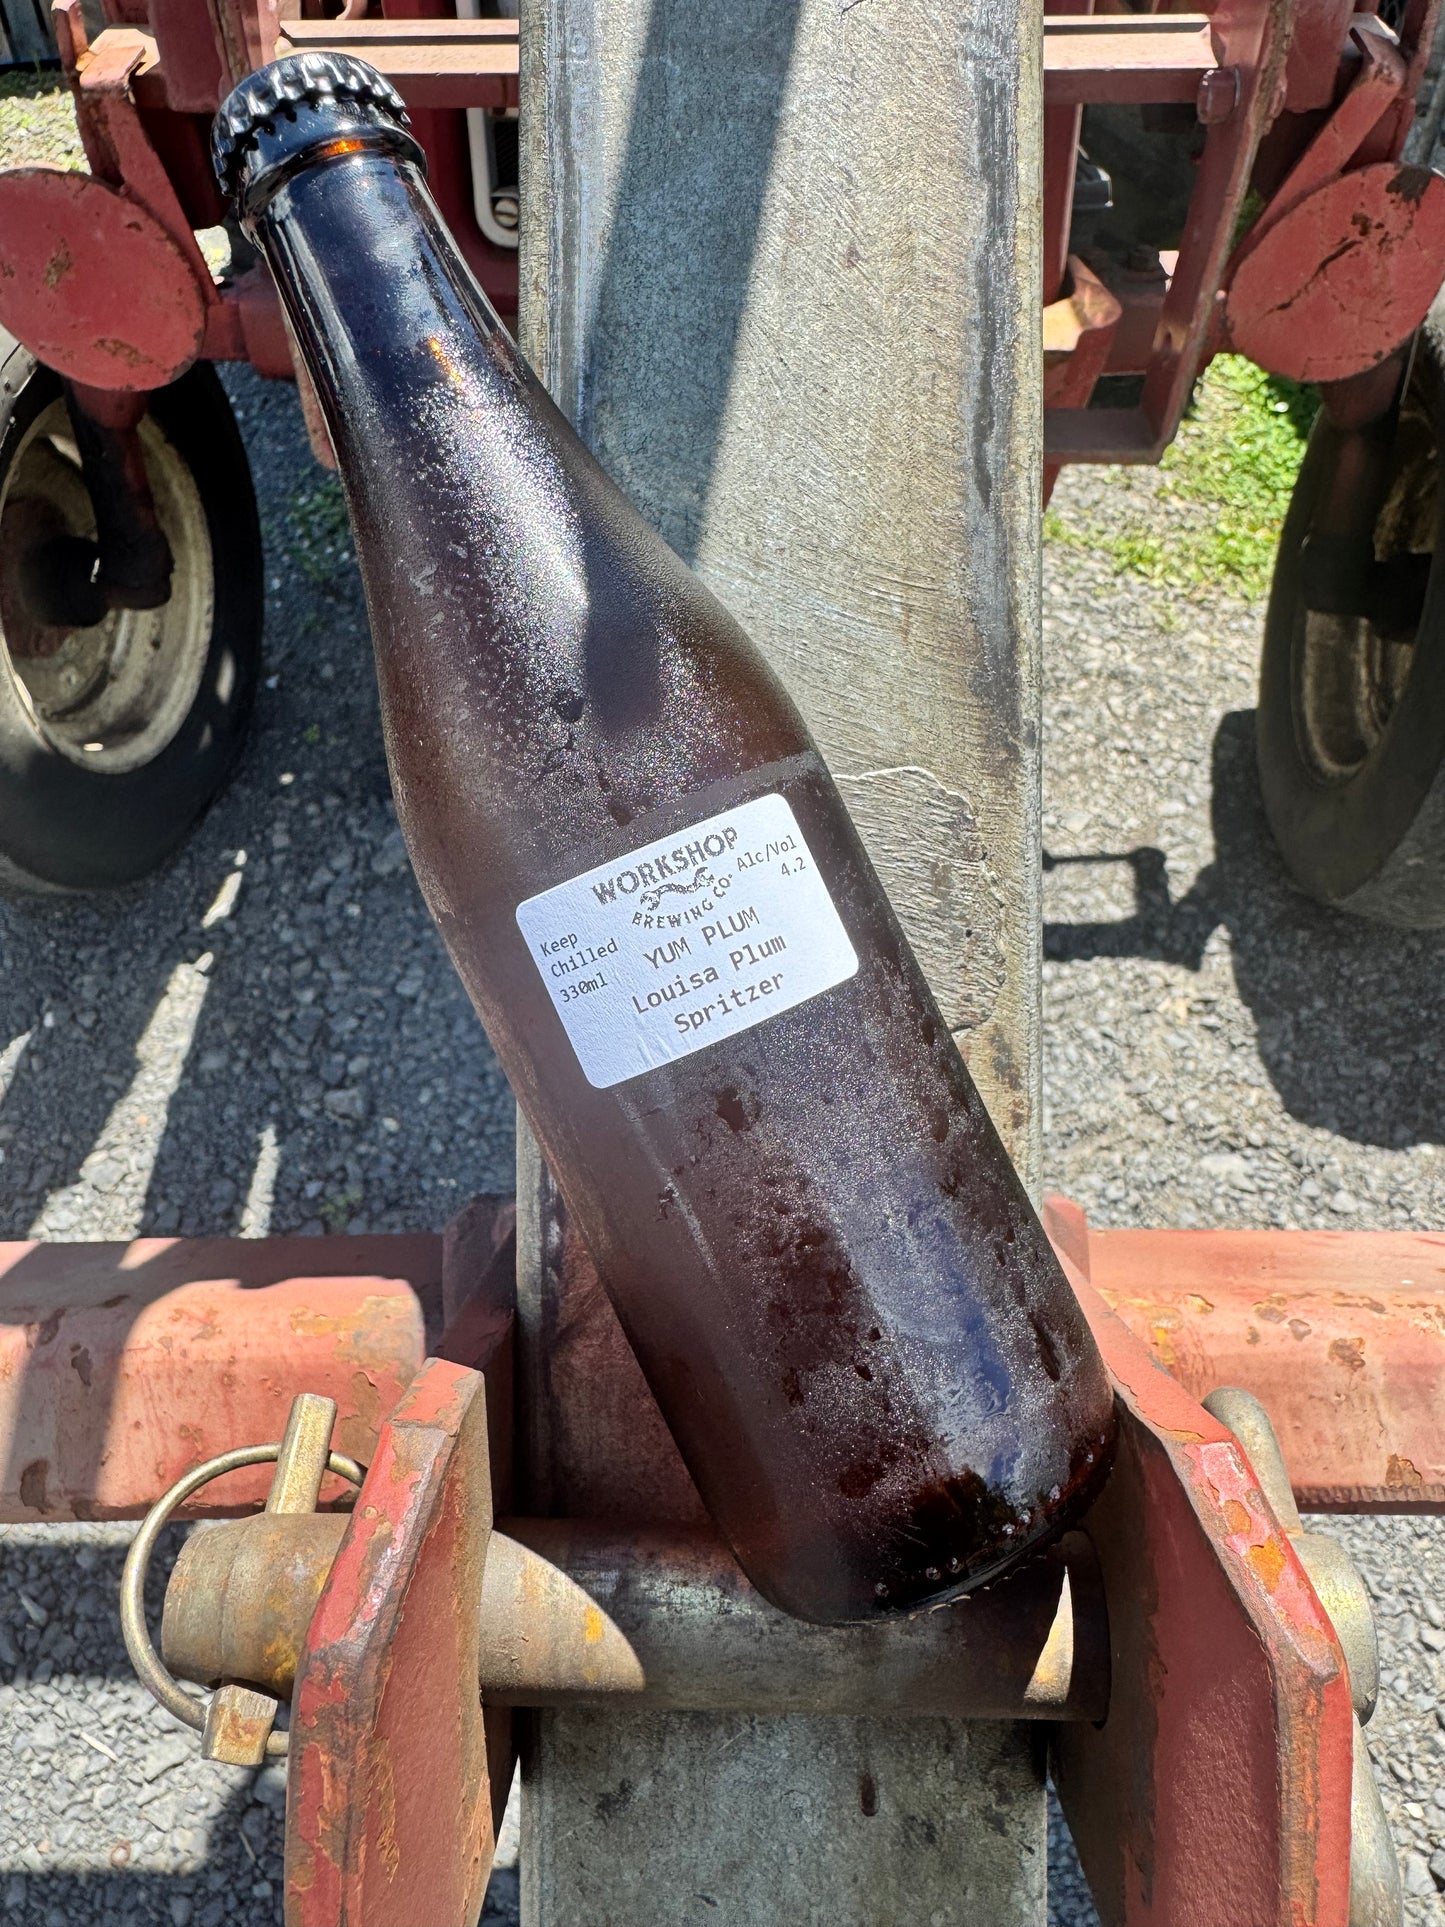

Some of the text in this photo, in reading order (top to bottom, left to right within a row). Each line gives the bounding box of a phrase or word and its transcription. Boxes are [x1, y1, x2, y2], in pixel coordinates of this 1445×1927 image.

[591, 826, 738, 906] WORKSHOP
[736, 835, 797, 872] Alc/Vol
[780, 857, 807, 877] 4.2
[632, 899, 714, 929] BREWING
[540, 931, 579, 958] Keep
[643, 906, 760, 970] YUM PLUM
[551, 938, 619, 978] Chilled
[632, 935, 787, 1014] Louisa Plum
[559, 972, 608, 1003] 330ml
[674, 971, 784, 1034] Spritzer
